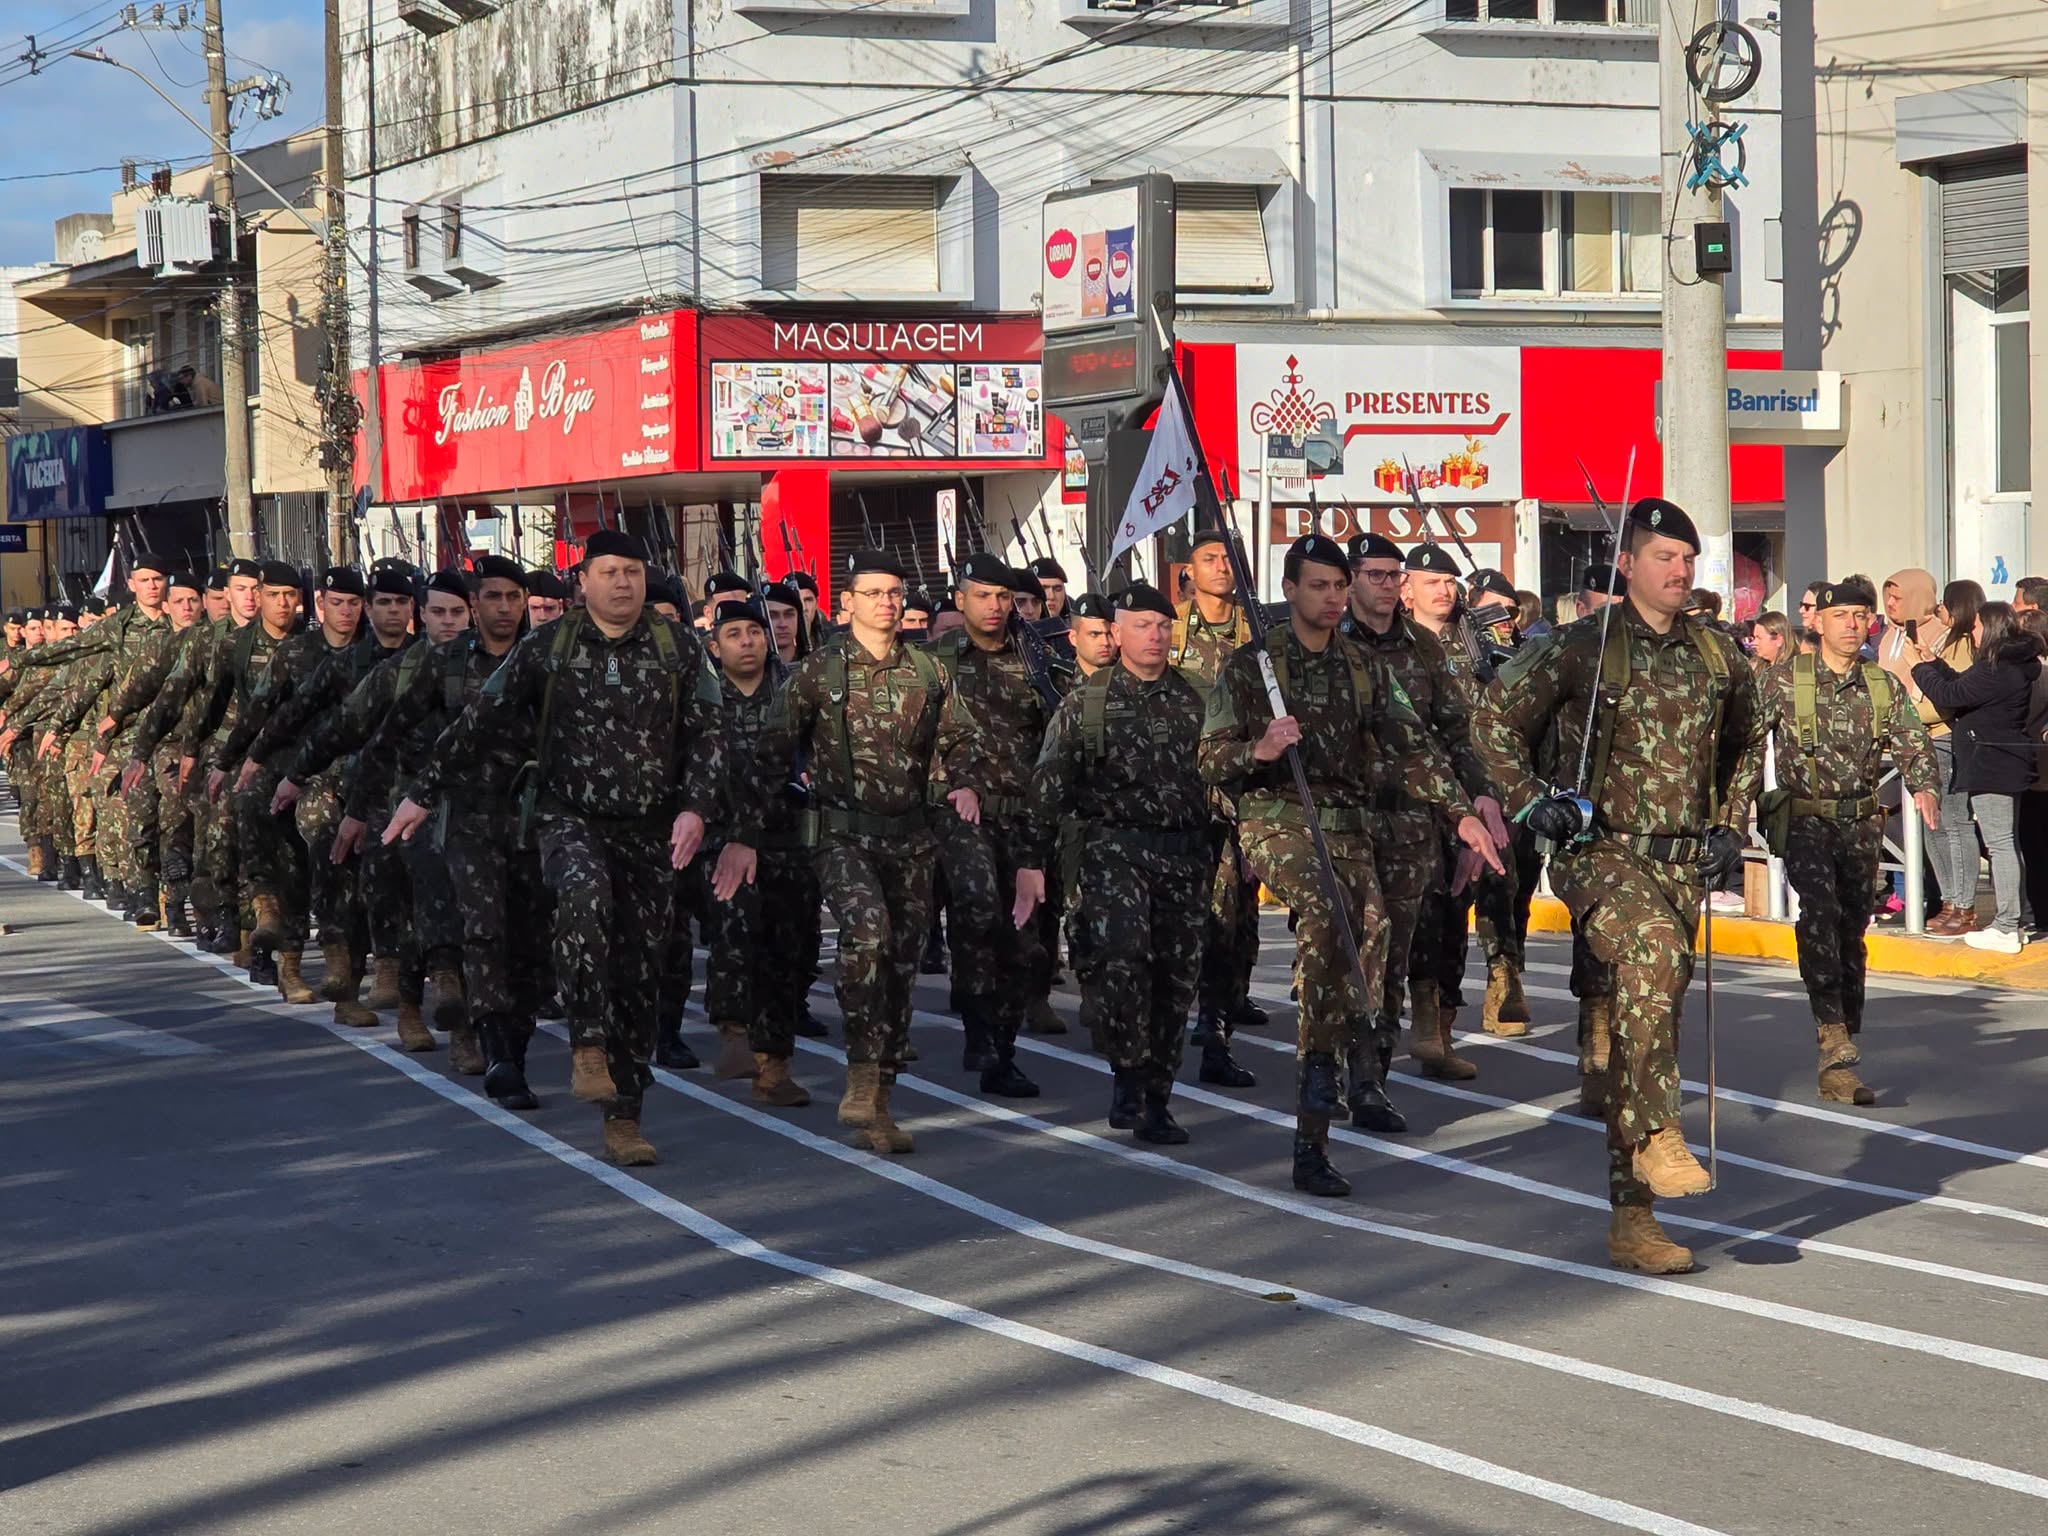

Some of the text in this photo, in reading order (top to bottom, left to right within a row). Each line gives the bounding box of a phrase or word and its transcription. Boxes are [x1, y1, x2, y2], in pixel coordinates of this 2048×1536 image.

[1049, 242, 1073, 263] URBANO
[773, 322, 983, 352] MAQUIAGEM
[435, 382, 510, 445] Fashion
[1345, 391, 1491, 414] PRESENTES
[1727, 388, 1818, 413] Banrisul
[1285, 507, 1478, 538] BOLSAS
